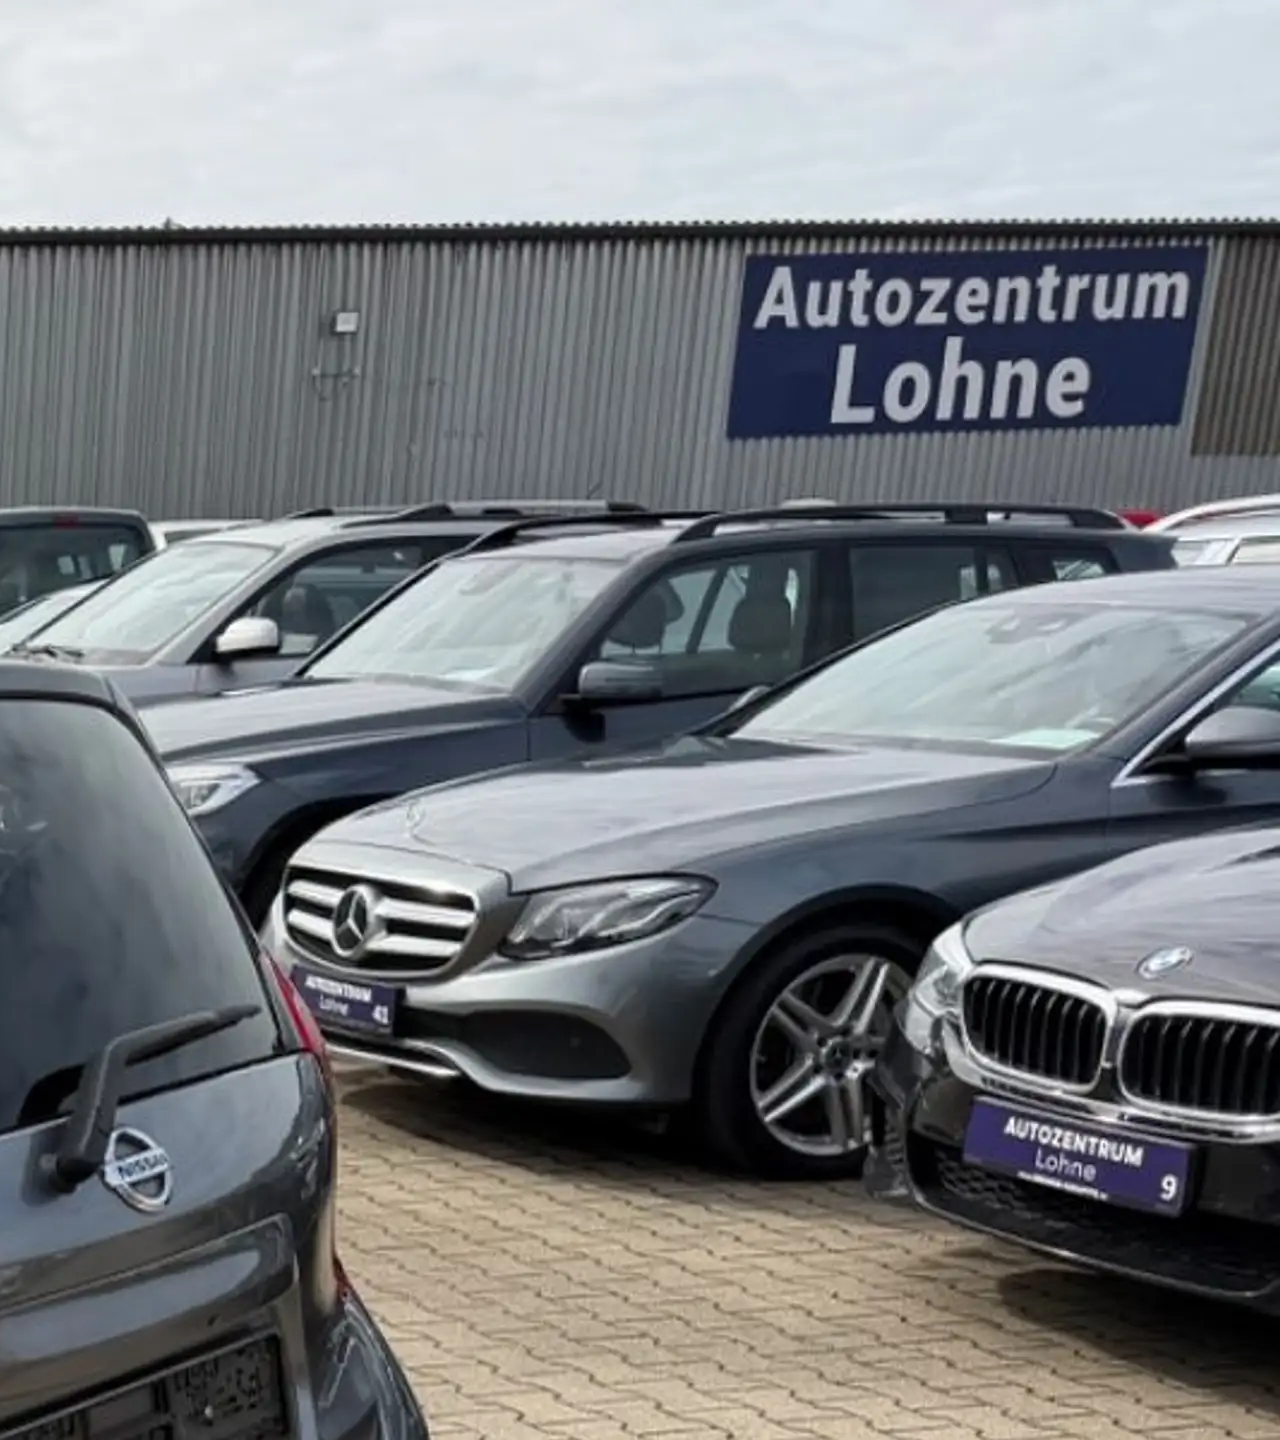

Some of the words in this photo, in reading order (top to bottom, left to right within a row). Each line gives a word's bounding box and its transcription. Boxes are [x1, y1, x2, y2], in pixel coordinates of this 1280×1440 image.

[753, 264, 1191, 329] Autozentrum
[830, 335, 1092, 424] Lohne
[1004, 1117, 1144, 1166] AUTOZENTRUM
[1034, 1148, 1097, 1182] Lohne
[1160, 1174, 1177, 1200] 9
